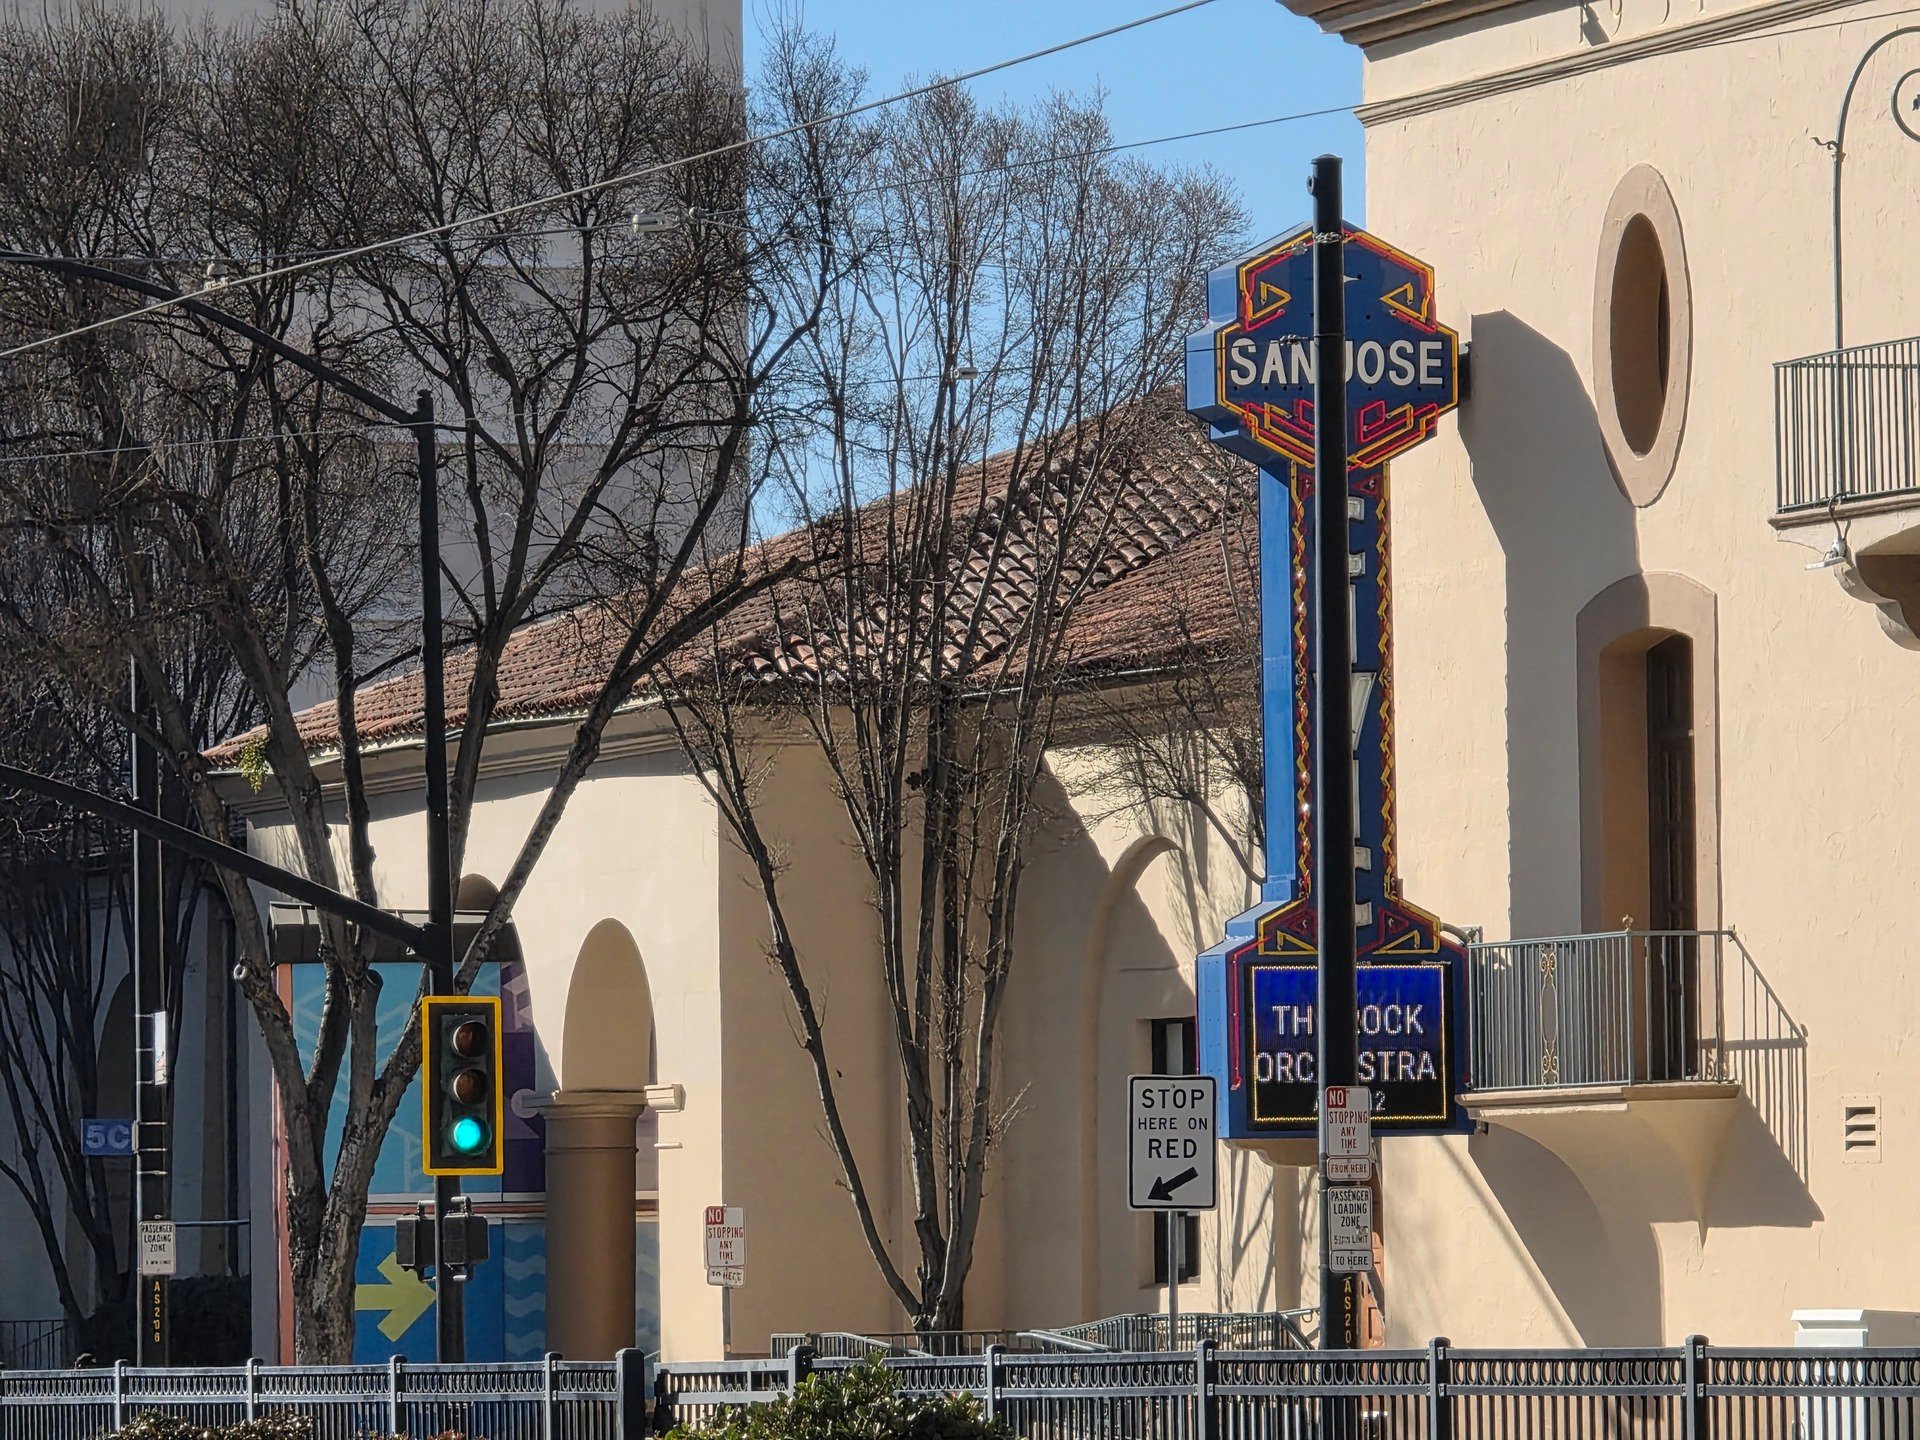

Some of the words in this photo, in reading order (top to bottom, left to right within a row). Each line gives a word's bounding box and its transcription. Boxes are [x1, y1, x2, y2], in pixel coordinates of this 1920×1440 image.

[1230, 338, 1315, 386] SAN
[1272, 1005, 1313, 1035] TH
[1357, 1004, 1424, 1035] OCK
[1256, 1051, 1437, 1081] ORCSTRA
[1141, 1088, 1205, 1109] STOP
[1329, 1090, 1344, 1106] NO
[1328, 1110, 1368, 1124] STOPPING
[1138, 1117, 1178, 1130] HERE
[1188, 1117, 1208, 1130] ON
[85, 1124, 130, 1150] 5C
[1340, 1126, 1356, 1137] ANY
[1148, 1138, 1197, 1159] RED
[1341, 1138, 1357, 1149] TIME
[1330, 1164, 1349, 1173] FROM
[1350, 1164, 1367, 1173] HERE
[1331, 1190, 1369, 1202] PASSENGER
[1333, 1203, 1367, 1215] LOADING
[708, 1208, 723, 1223] NO
[1341, 1216, 1360, 1227] ZONE
[142, 1224, 173, 1233] PASSENGER
[708, 1226, 743, 1239] STOPPING
[144, 1234, 172, 1243] LOADING
[150, 1244, 167, 1253] ZONE
[719, 1240, 733, 1250] ANY
[719, 1251, 733, 1260] TIME
[1336, 1256, 1345, 1266] TO
[1347, 1256, 1369, 1266] HERE
[1344, 1280, 1352, 1349] AS20
